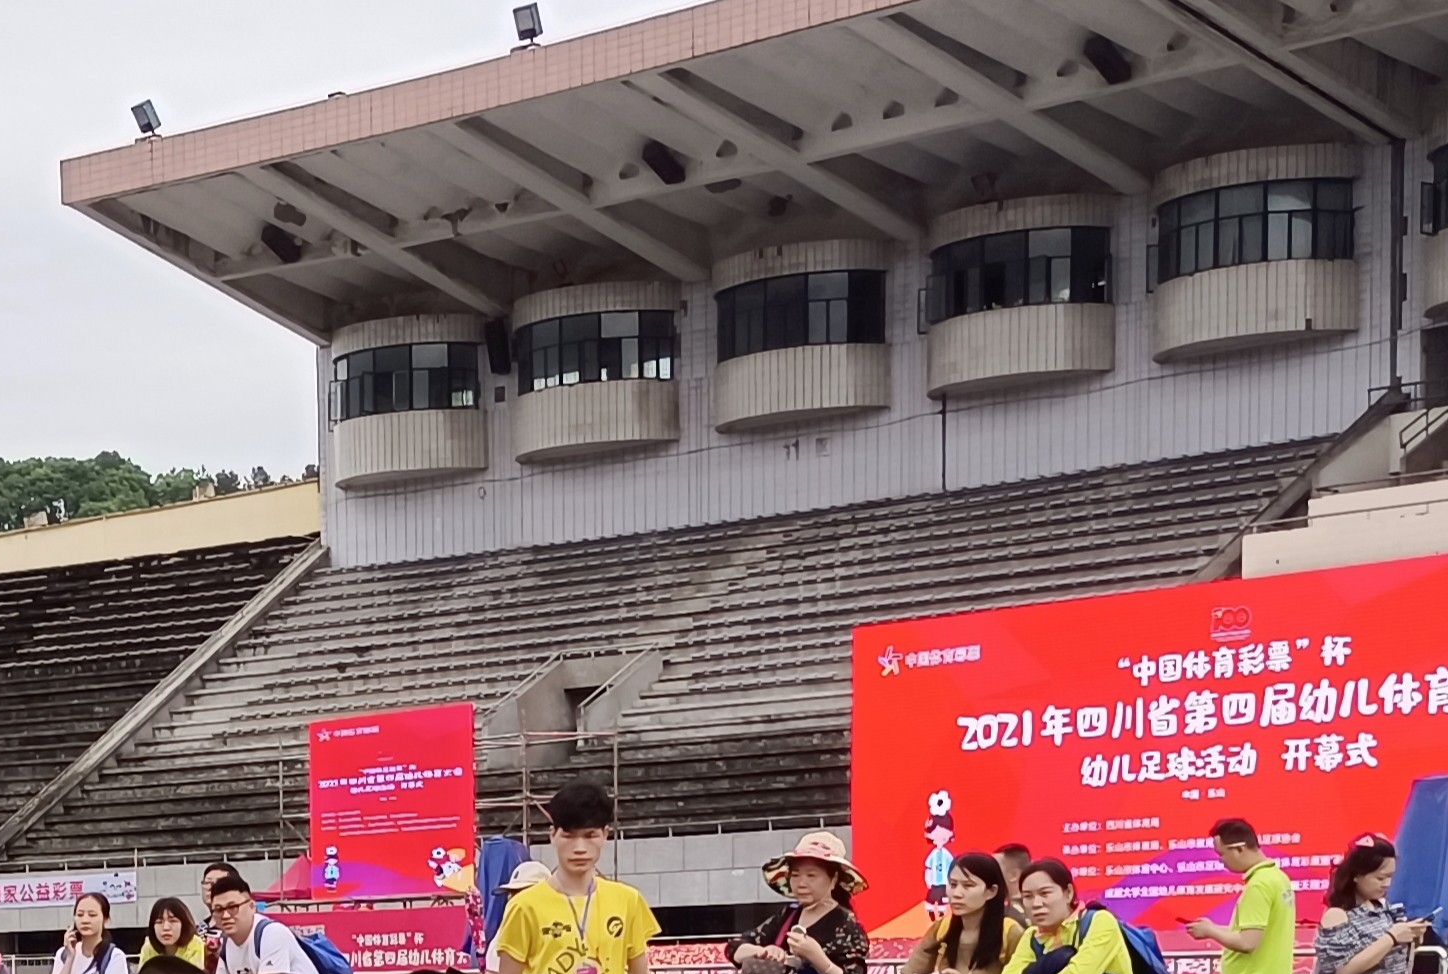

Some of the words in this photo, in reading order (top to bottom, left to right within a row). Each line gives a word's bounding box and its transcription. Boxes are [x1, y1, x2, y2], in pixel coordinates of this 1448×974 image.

[1080, 741, 1258, 788] 幼儿足球活动
[1280, 732, 1379, 773] 开幕式
